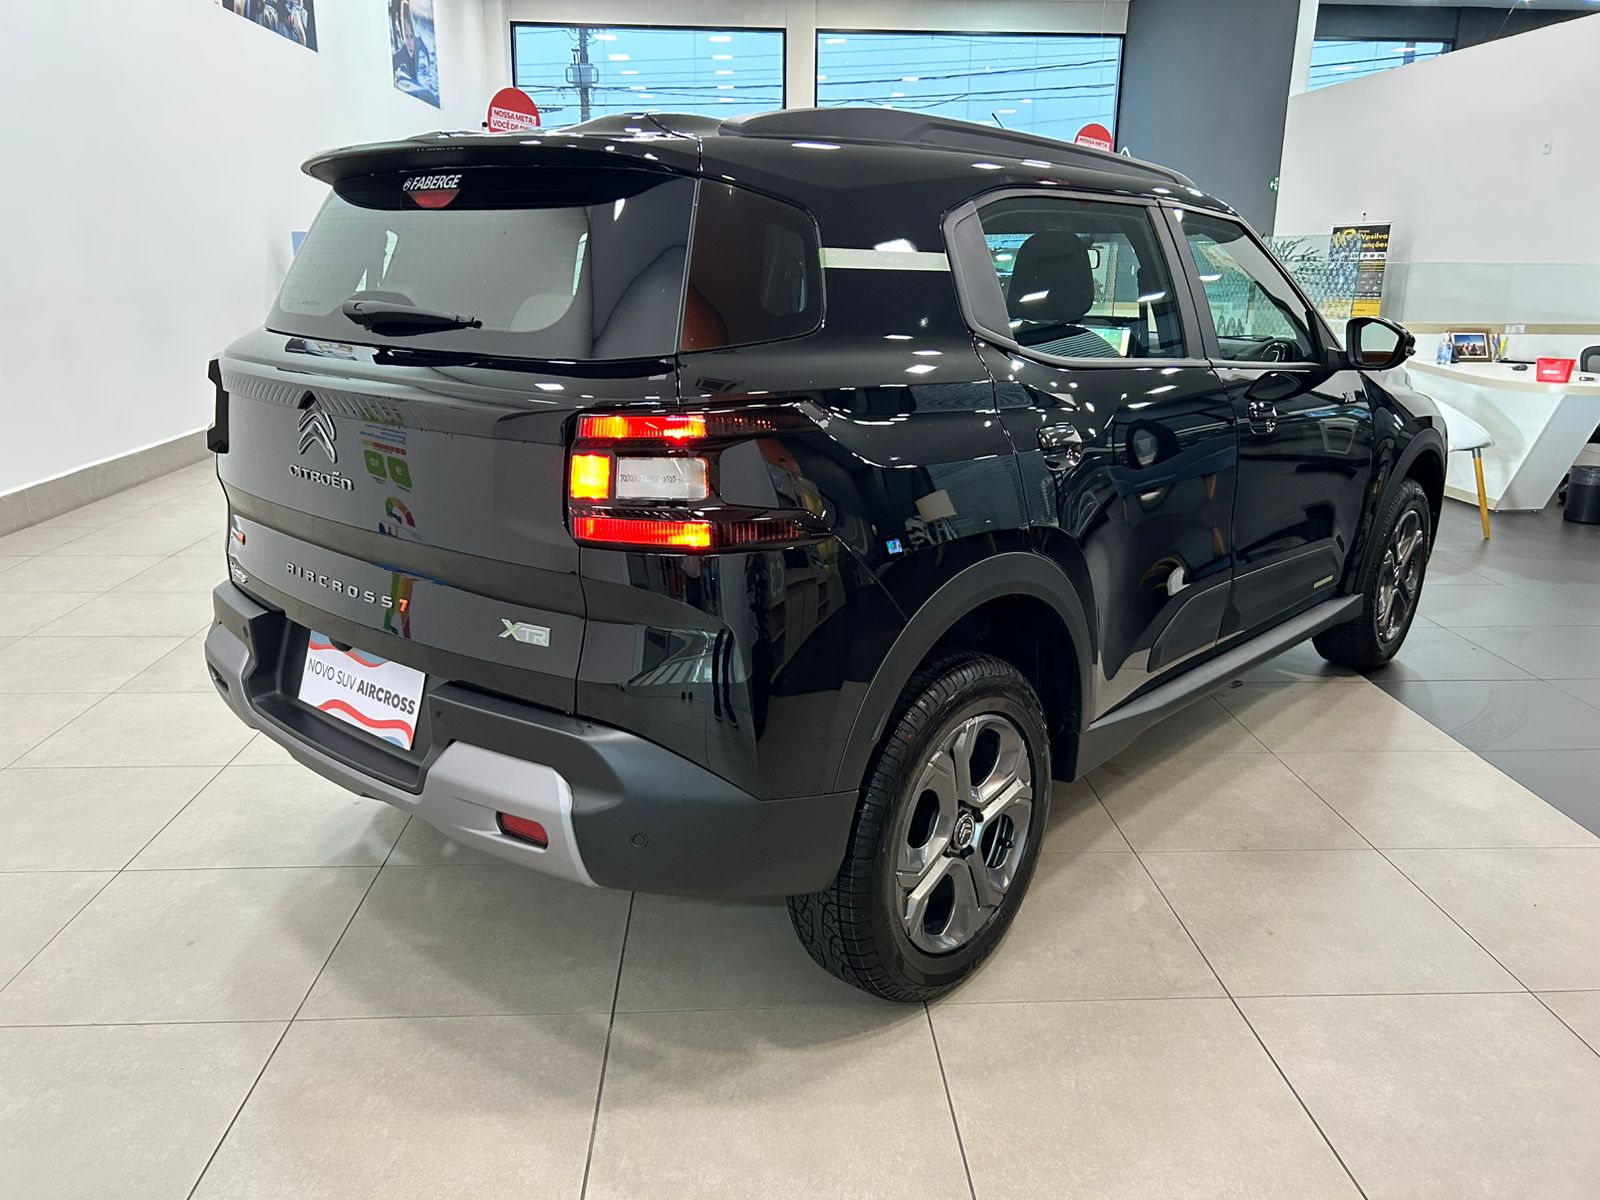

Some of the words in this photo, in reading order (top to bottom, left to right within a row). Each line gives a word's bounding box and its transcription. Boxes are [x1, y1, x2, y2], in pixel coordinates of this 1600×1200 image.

[493, 109, 515, 120] NOSSA
[410, 174, 462, 190] FABERGE
[499, 618, 551, 647] XTR
[307, 658, 335, 680] NOVO
[336, 670, 357, 690] SUV
[356, 680, 416, 715] AIRCROSS
